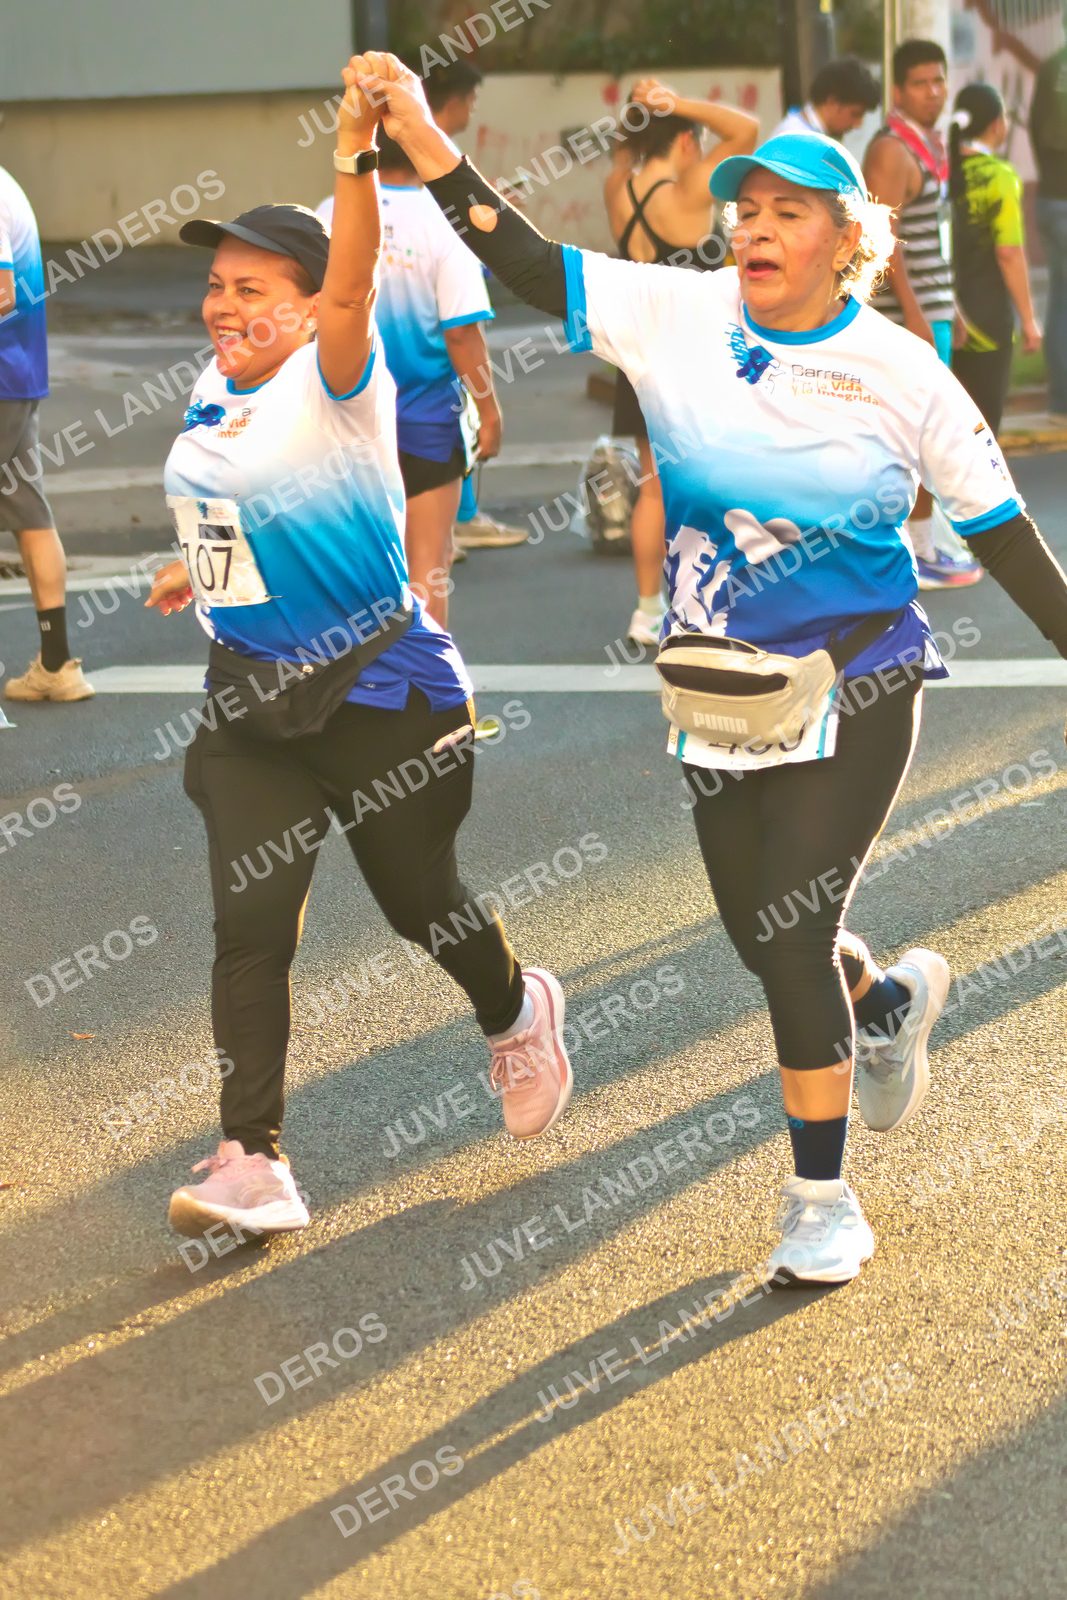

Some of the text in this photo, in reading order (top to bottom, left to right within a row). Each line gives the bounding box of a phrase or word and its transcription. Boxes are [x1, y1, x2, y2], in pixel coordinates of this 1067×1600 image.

[792, 364, 862, 384] Carrera
[831, 380, 863, 393] Vida
[693, 711, 749, 734] PUMA
